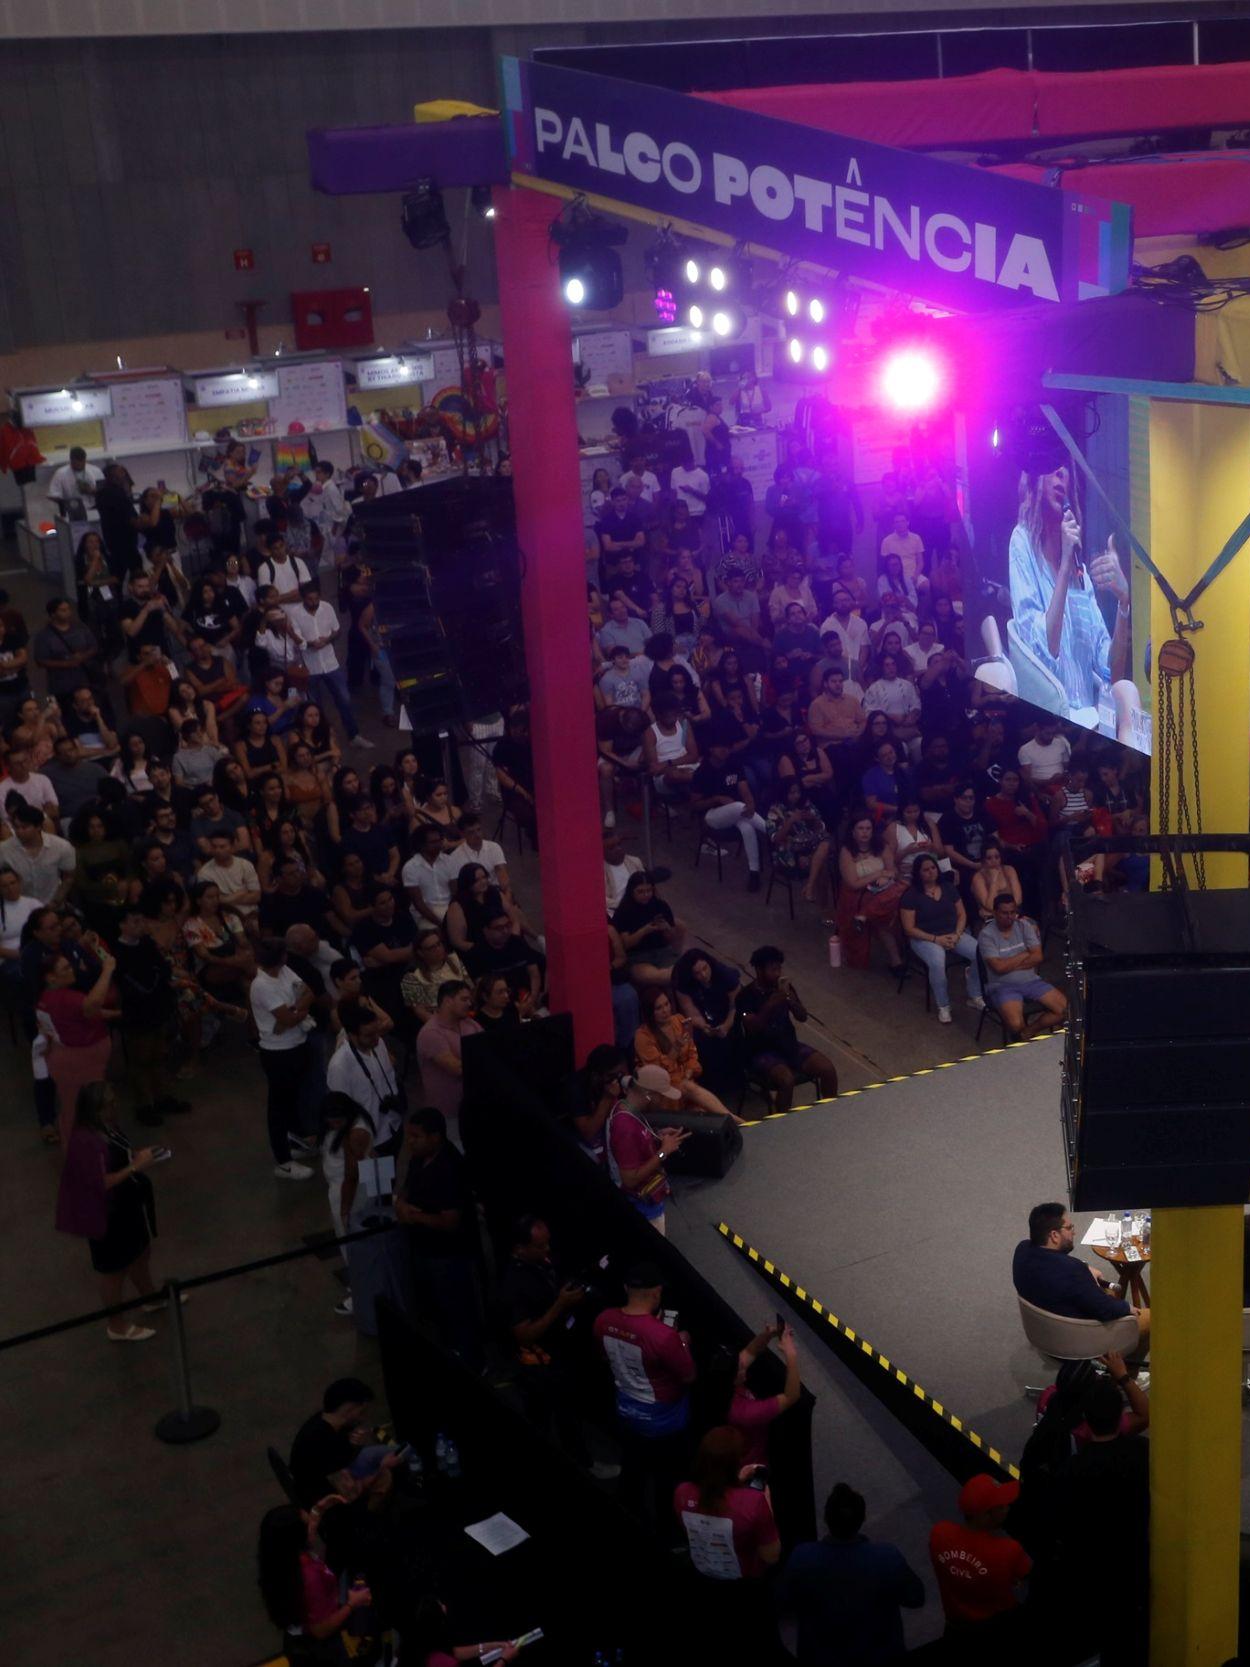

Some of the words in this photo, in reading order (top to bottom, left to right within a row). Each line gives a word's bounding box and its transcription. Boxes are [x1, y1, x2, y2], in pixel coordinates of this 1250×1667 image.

[534, 108, 702, 194] PALCO
[713, 154, 1060, 302] POTÊNCIA
[937, 1549, 989, 1576] BOMBEIRO
